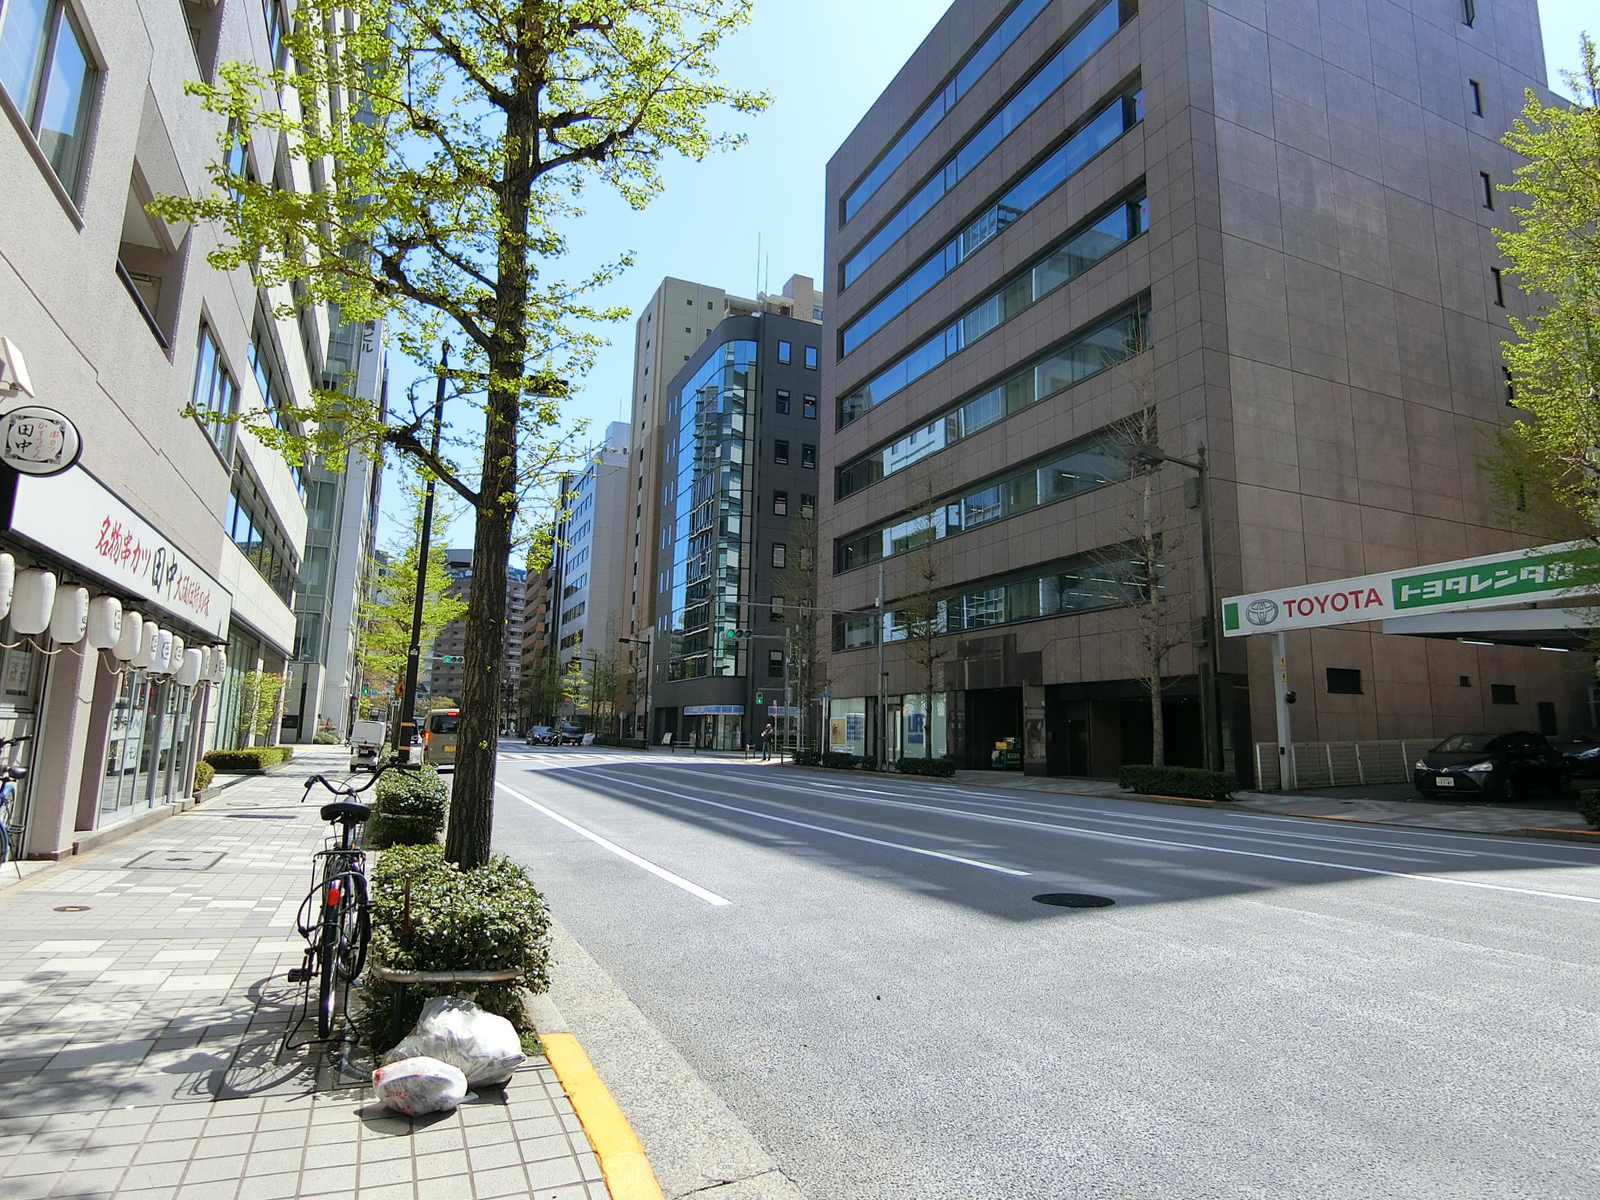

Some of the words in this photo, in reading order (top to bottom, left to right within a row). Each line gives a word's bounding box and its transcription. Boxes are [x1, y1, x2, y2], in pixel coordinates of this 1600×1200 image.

[15, 423, 34, 454] 田中
[95, 514, 152, 579] 名物串カツ
[152, 546, 178, 602] 田中
[1283, 587, 1384, 618] TOYOTA
